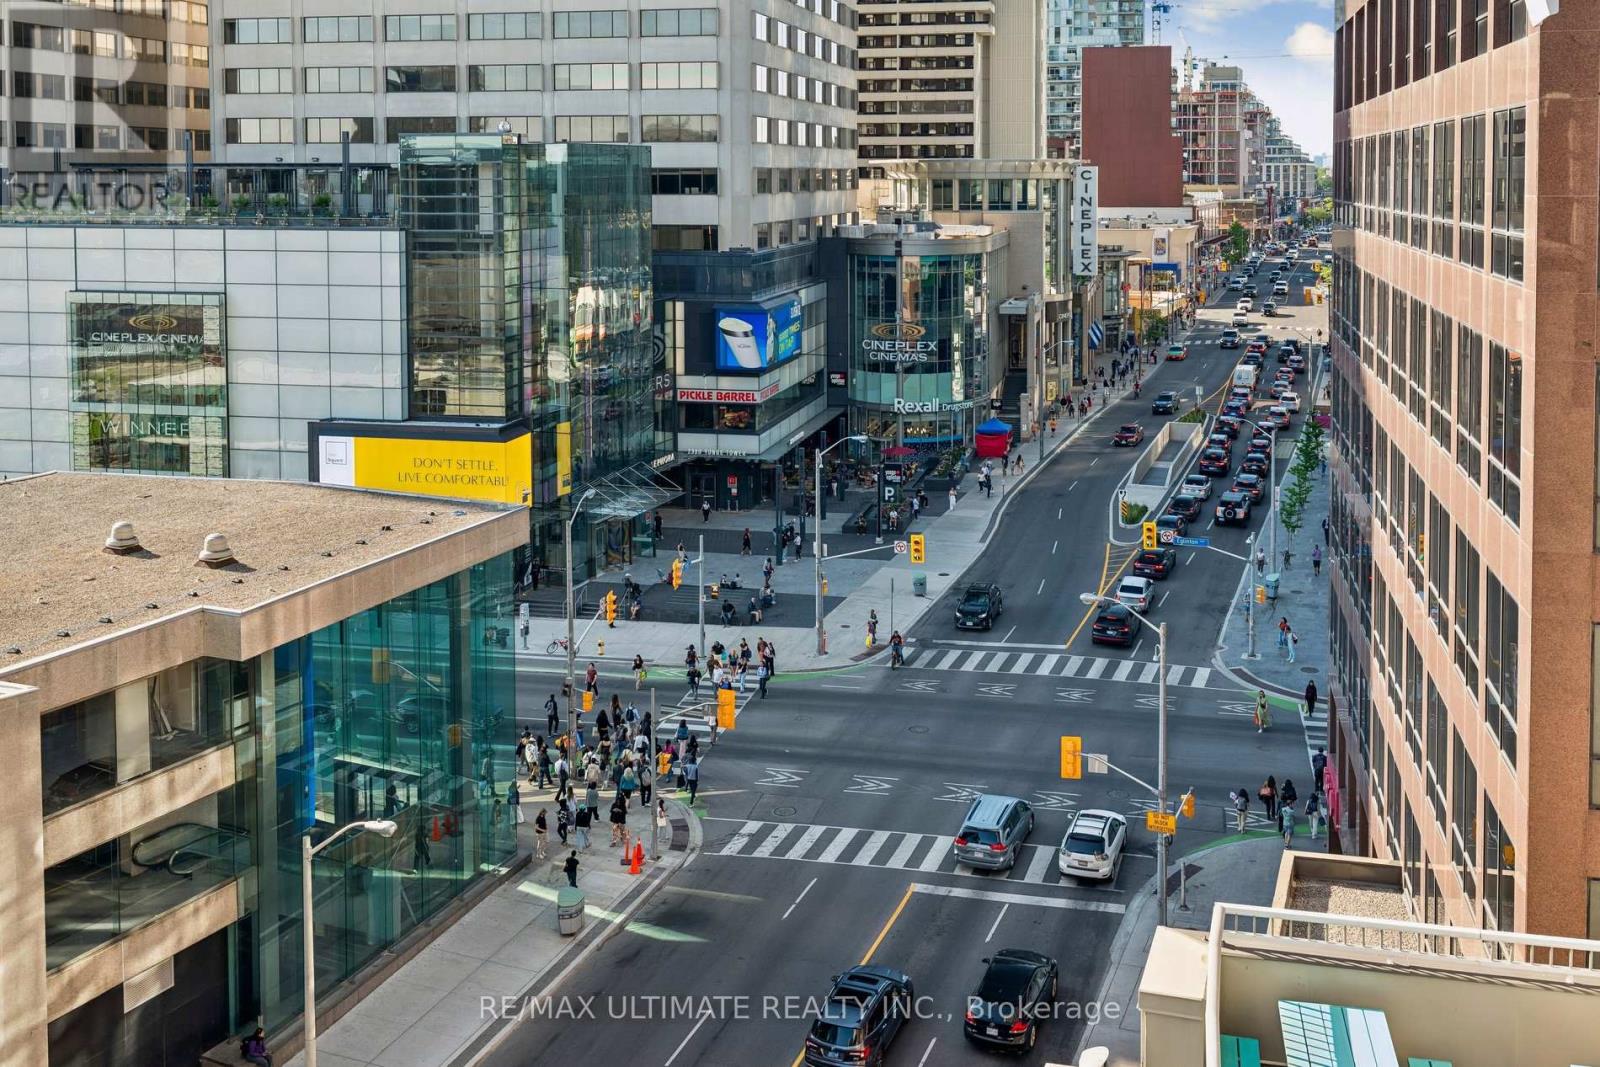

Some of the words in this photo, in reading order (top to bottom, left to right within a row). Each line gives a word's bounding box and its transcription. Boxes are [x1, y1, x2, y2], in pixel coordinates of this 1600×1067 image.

[1081, 170, 1092, 273] CINEPLEX
[91, 331, 153, 343] CINEPLEX
[862, 339, 937, 351] CINEPLEX
[869, 351, 928, 362] CINEMAS
[679, 390, 713, 401] PICKLE
[716, 391, 757, 402] BARREL
[893, 397, 939, 414] Rexall
[942, 400, 974, 412] Drugstore
[413, 457, 453, 469] DON'T
[398, 472, 422, 483] LIVE
[425, 472, 509, 487] COMFORTABL
